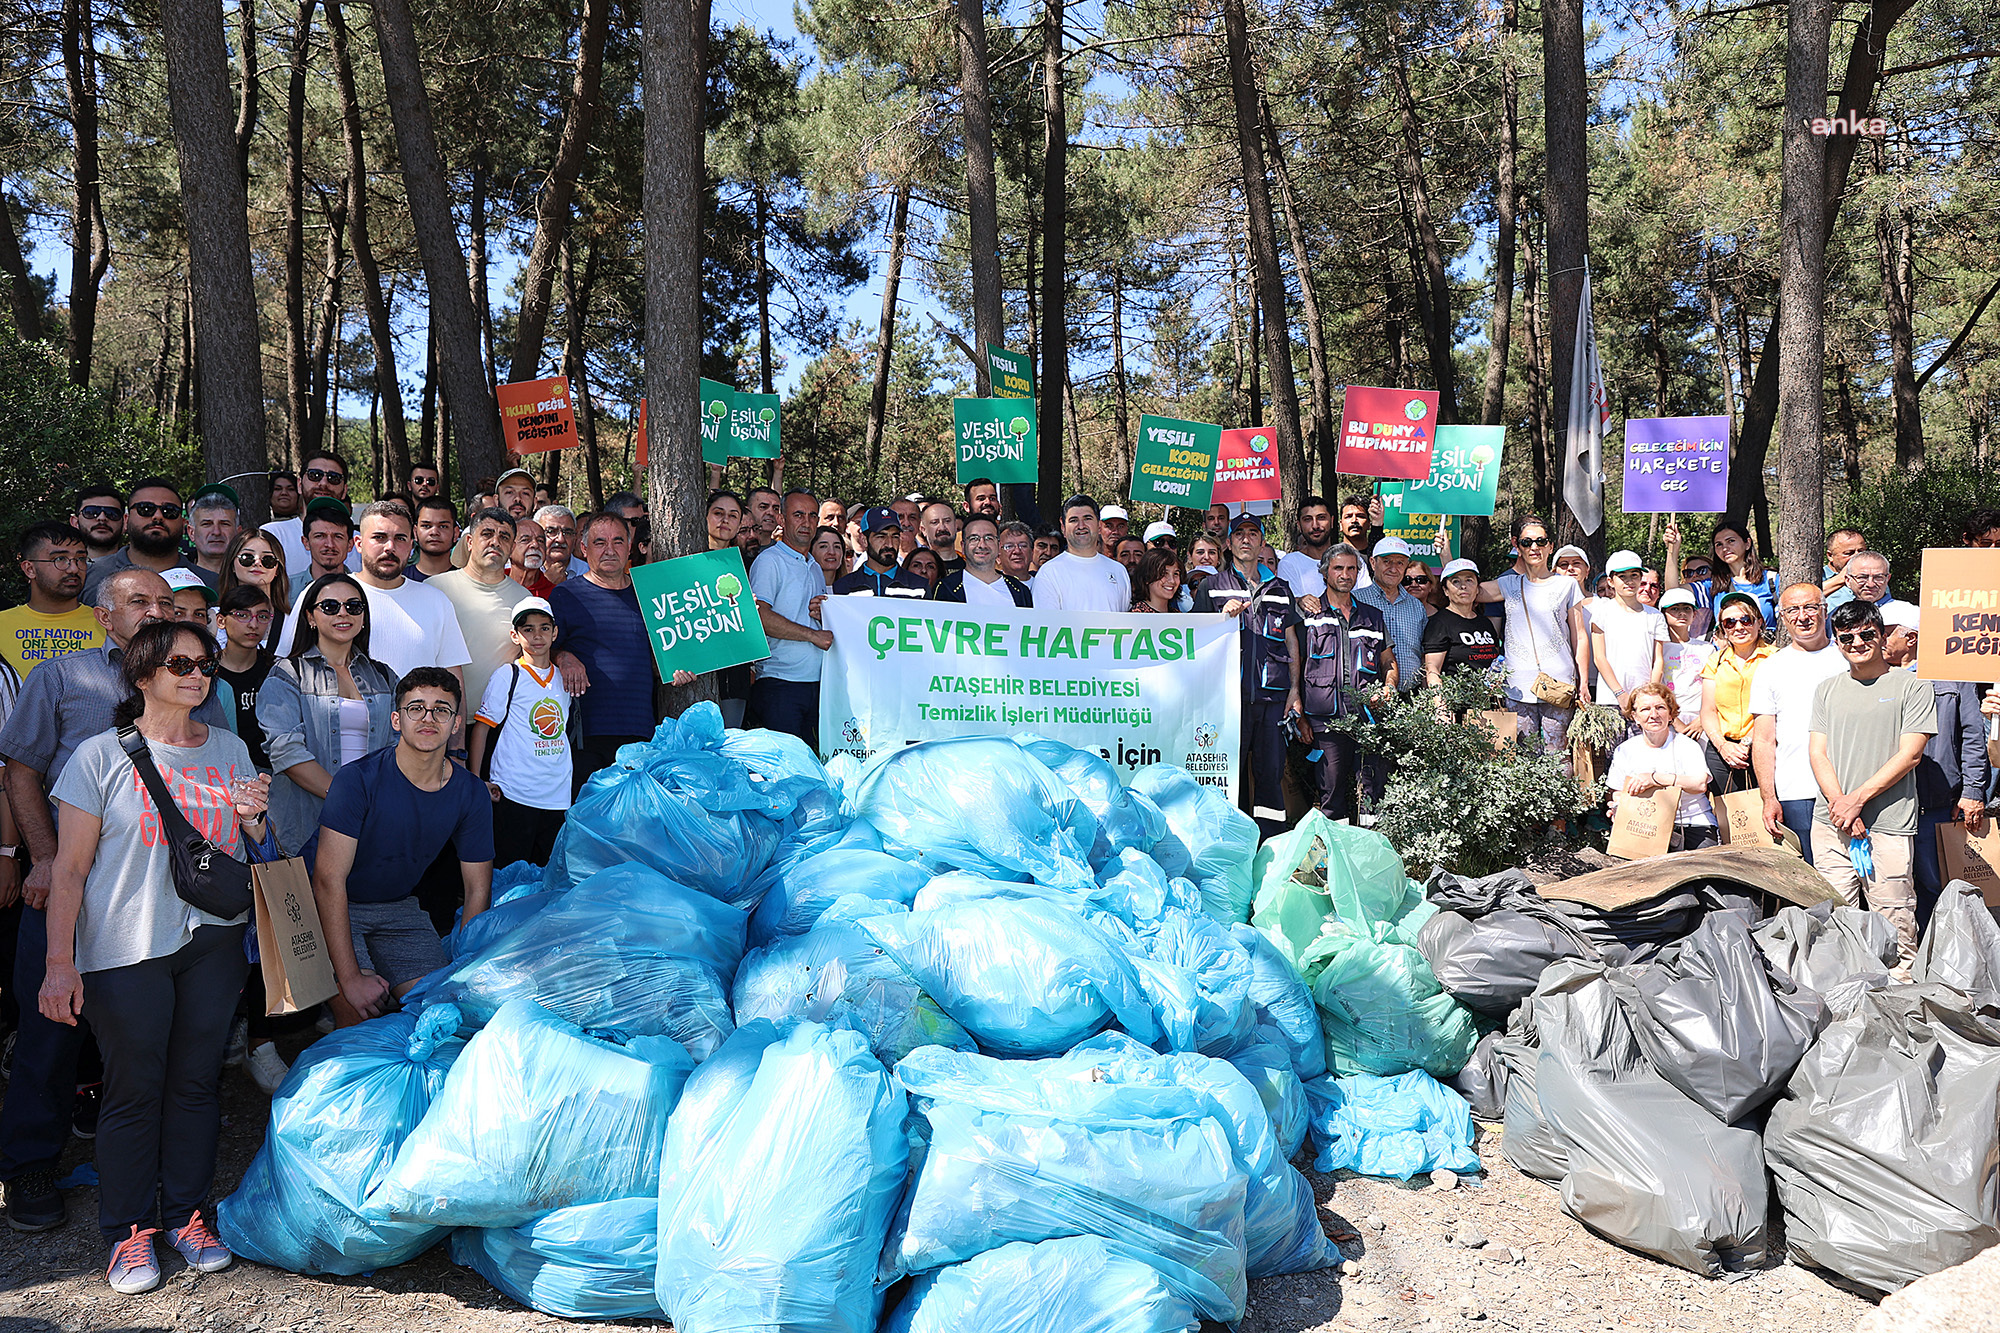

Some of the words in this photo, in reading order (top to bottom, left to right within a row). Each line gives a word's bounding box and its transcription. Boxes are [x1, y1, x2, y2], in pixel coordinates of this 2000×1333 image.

[1004, 374, 1030, 392] KORU
[537, 397, 567, 413] DEĞİL
[731, 407, 761, 424] EŞİL
[730, 423, 770, 442] ÜŞÜN!
[962, 417, 1012, 440] YEŞİL
[1348, 420, 1369, 435] BU
[1372, 422, 1426, 438] DÜNYA
[960, 440, 1024, 463] DÜŞÜN!
[1345, 435, 1428, 453] HEPİMİZİN
[1629, 439, 1697, 453] GELECEĞİM
[1699, 438, 1724, 453] İÇİN
[1168, 449, 1211, 468] KORU
[1215, 459, 1224, 470] U
[1227, 456, 1272, 469] DÜNYA
[1430, 445, 1472, 469] EŞİL
[1629, 456, 1723, 475] HAREKETE
[1141, 463, 1208, 482] GELECEĞİNİ
[1214, 467, 1275, 482] EPİMİZİN
[1152, 480, 1191, 497] KORU!
[1660, 479, 1689, 492] GEÇ
[1407, 544, 1436, 556] ORU!
[651, 581, 723, 620] YEŞİL
[655, 607, 745, 651] DÜŞÜN!
[1952, 612, 2000, 633] KEN
[44, 628, 93, 640] NATION
[868, 615, 1010, 660] ÇEVRE
[1020, 625, 1196, 661] HAFTASI
[1459, 631, 1494, 645] D&G
[1945, 632, 2000, 656] DEĞİ
[928, 674, 1024, 697] ATAŞEHİR
[1029, 676, 1140, 697] BELEDİYESİ
[917, 703, 997, 722] Temizlik
[1001, 701, 1049, 726] İşleri
[1053, 706, 1152, 728] Müdürlüğü
[1117, 737, 1161, 771] İçin
